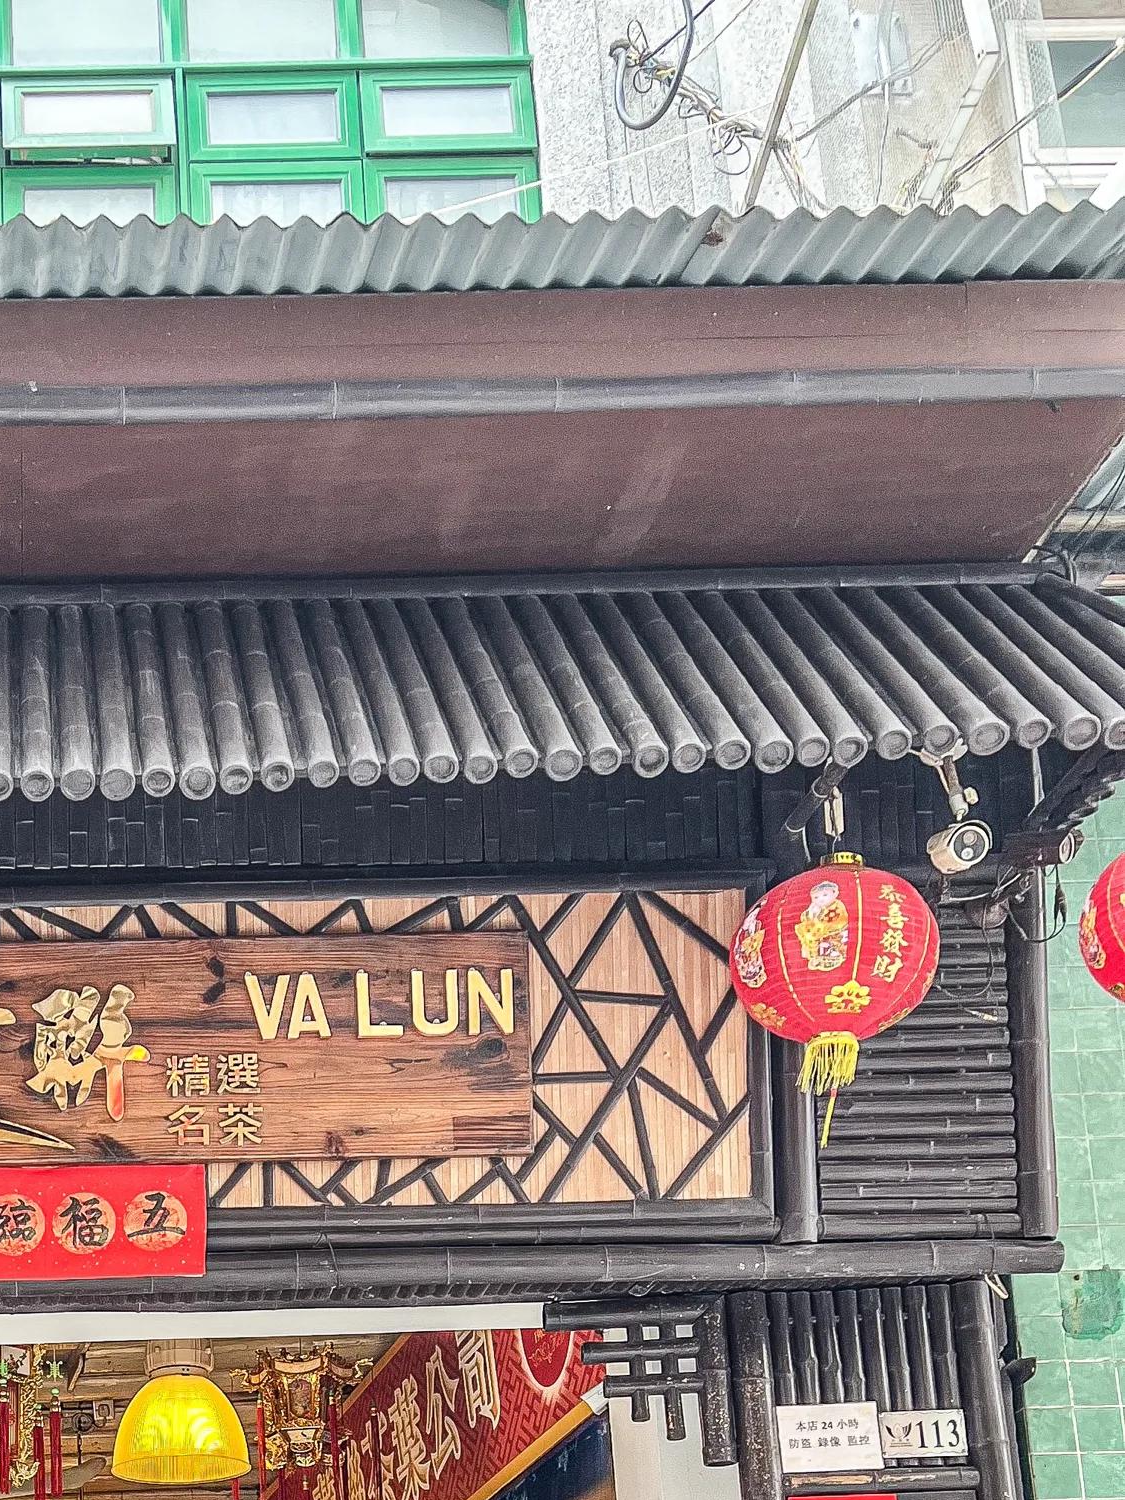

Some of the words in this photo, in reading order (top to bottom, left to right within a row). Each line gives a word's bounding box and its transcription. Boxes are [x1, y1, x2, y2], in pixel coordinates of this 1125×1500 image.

[245, 968, 333, 1040] VA
[356, 965, 516, 1038] LUN
[165, 1053, 262, 1097] 精選
[166, 1103, 265, 1149] 名茶
[789, 1438, 813, 1449] 防盜
[847, 1435, 870, 1446] 監控
[796, 1420, 818, 1432] 本店
[822, 1421, 833, 1430] 24
[837, 1418, 859, 1430] 小時
[915, 1419, 960, 1449] 113
